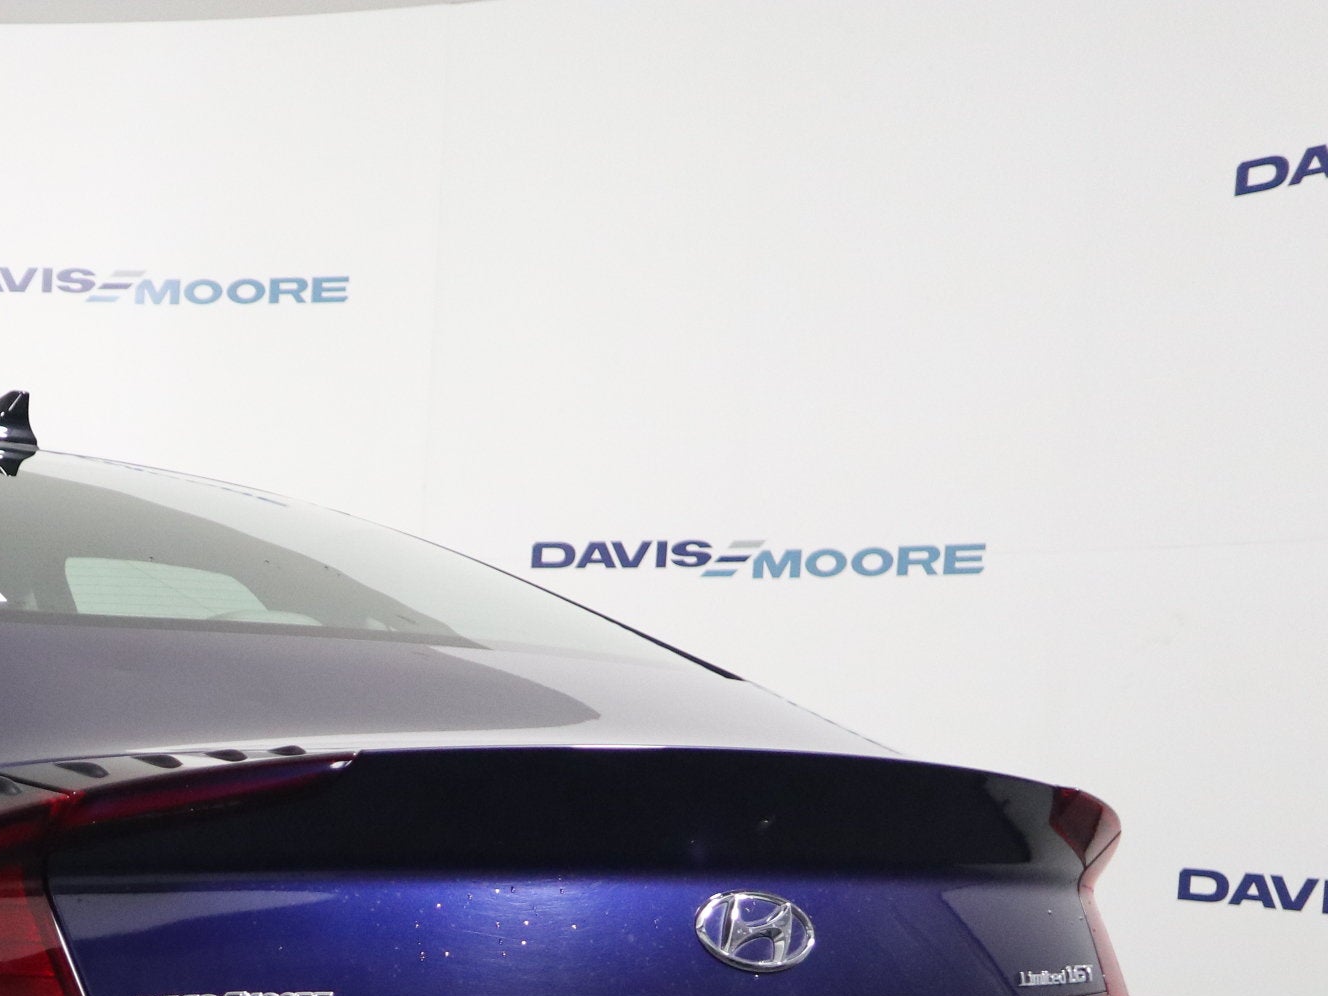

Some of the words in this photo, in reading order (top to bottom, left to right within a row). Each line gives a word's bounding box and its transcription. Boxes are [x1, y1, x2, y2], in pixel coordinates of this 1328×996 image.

[134, 276, 350, 305] MOORE
[530, 540, 712, 569] DAVIS
[752, 543, 987, 578] MOORE
[1018, 970, 1067, 987] Limited
